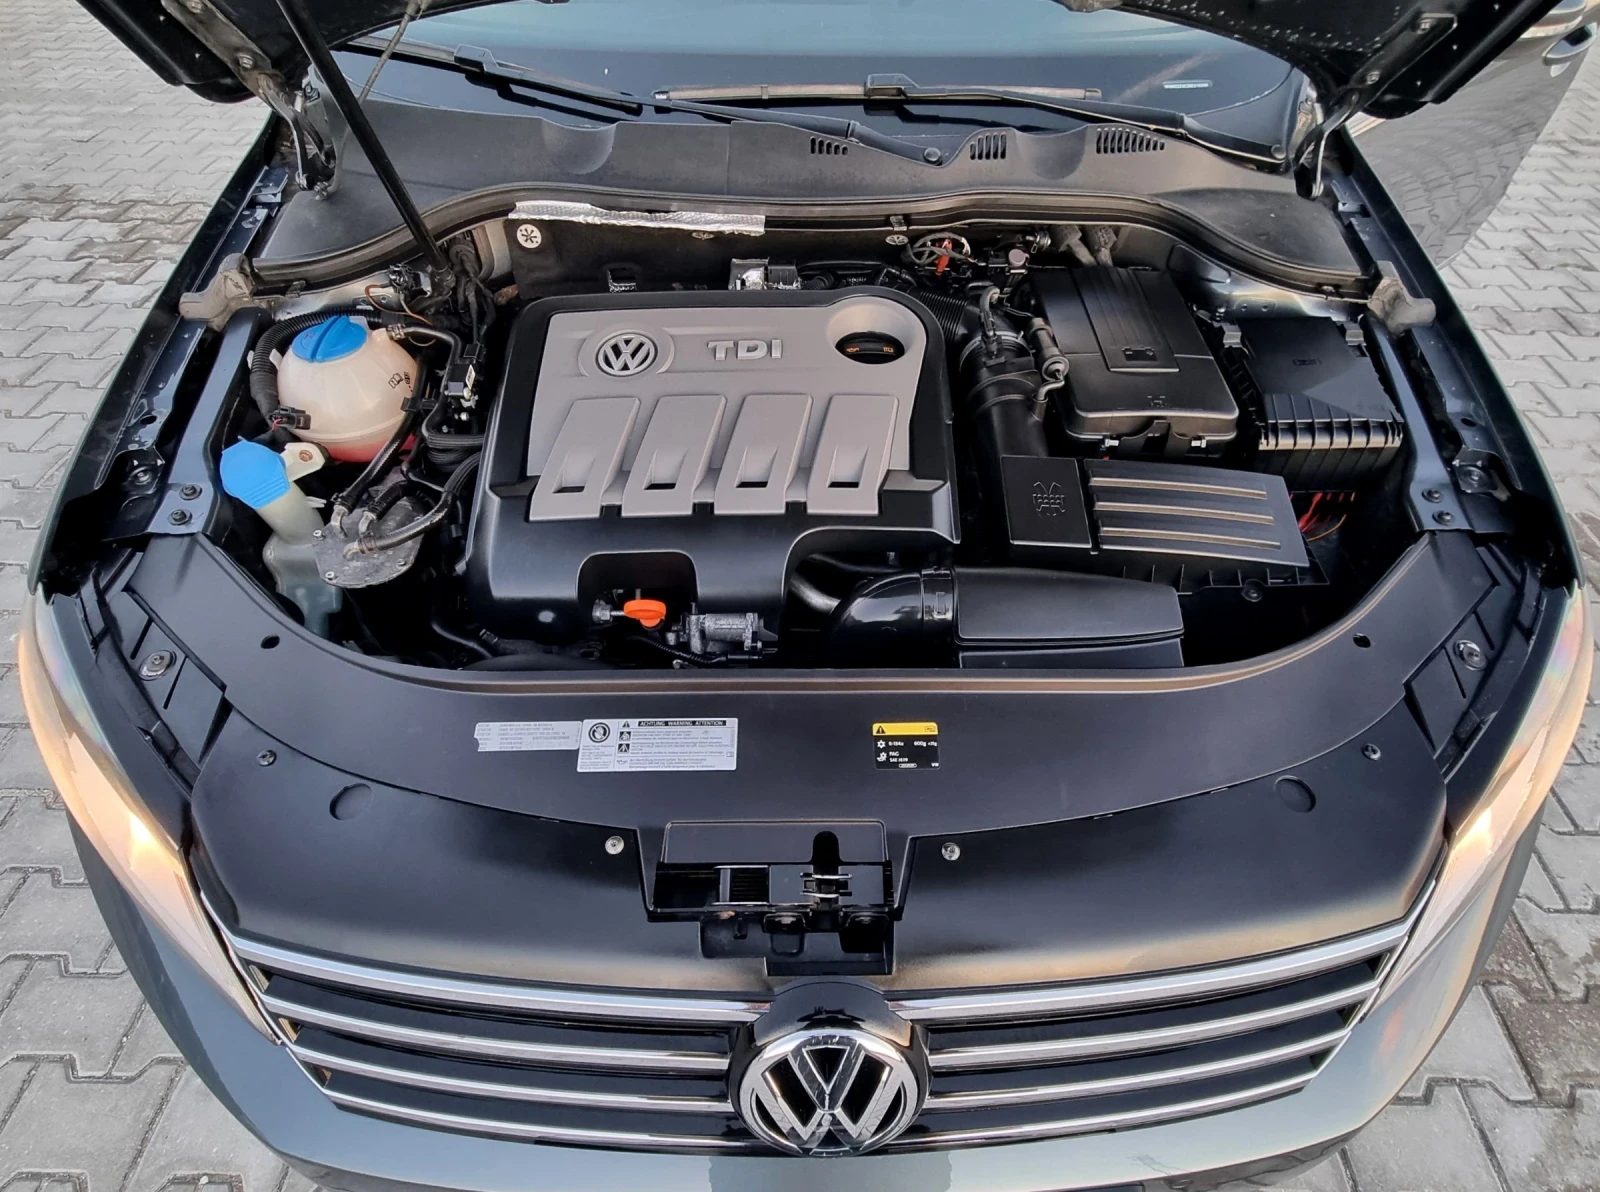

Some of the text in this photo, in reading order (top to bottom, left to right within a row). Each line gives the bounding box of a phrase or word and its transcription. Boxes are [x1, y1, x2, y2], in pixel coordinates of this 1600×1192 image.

[597, 332, 658, 376] VW
[707, 339, 783, 361] TDI
[740, 1028, 918, 1157] VW
